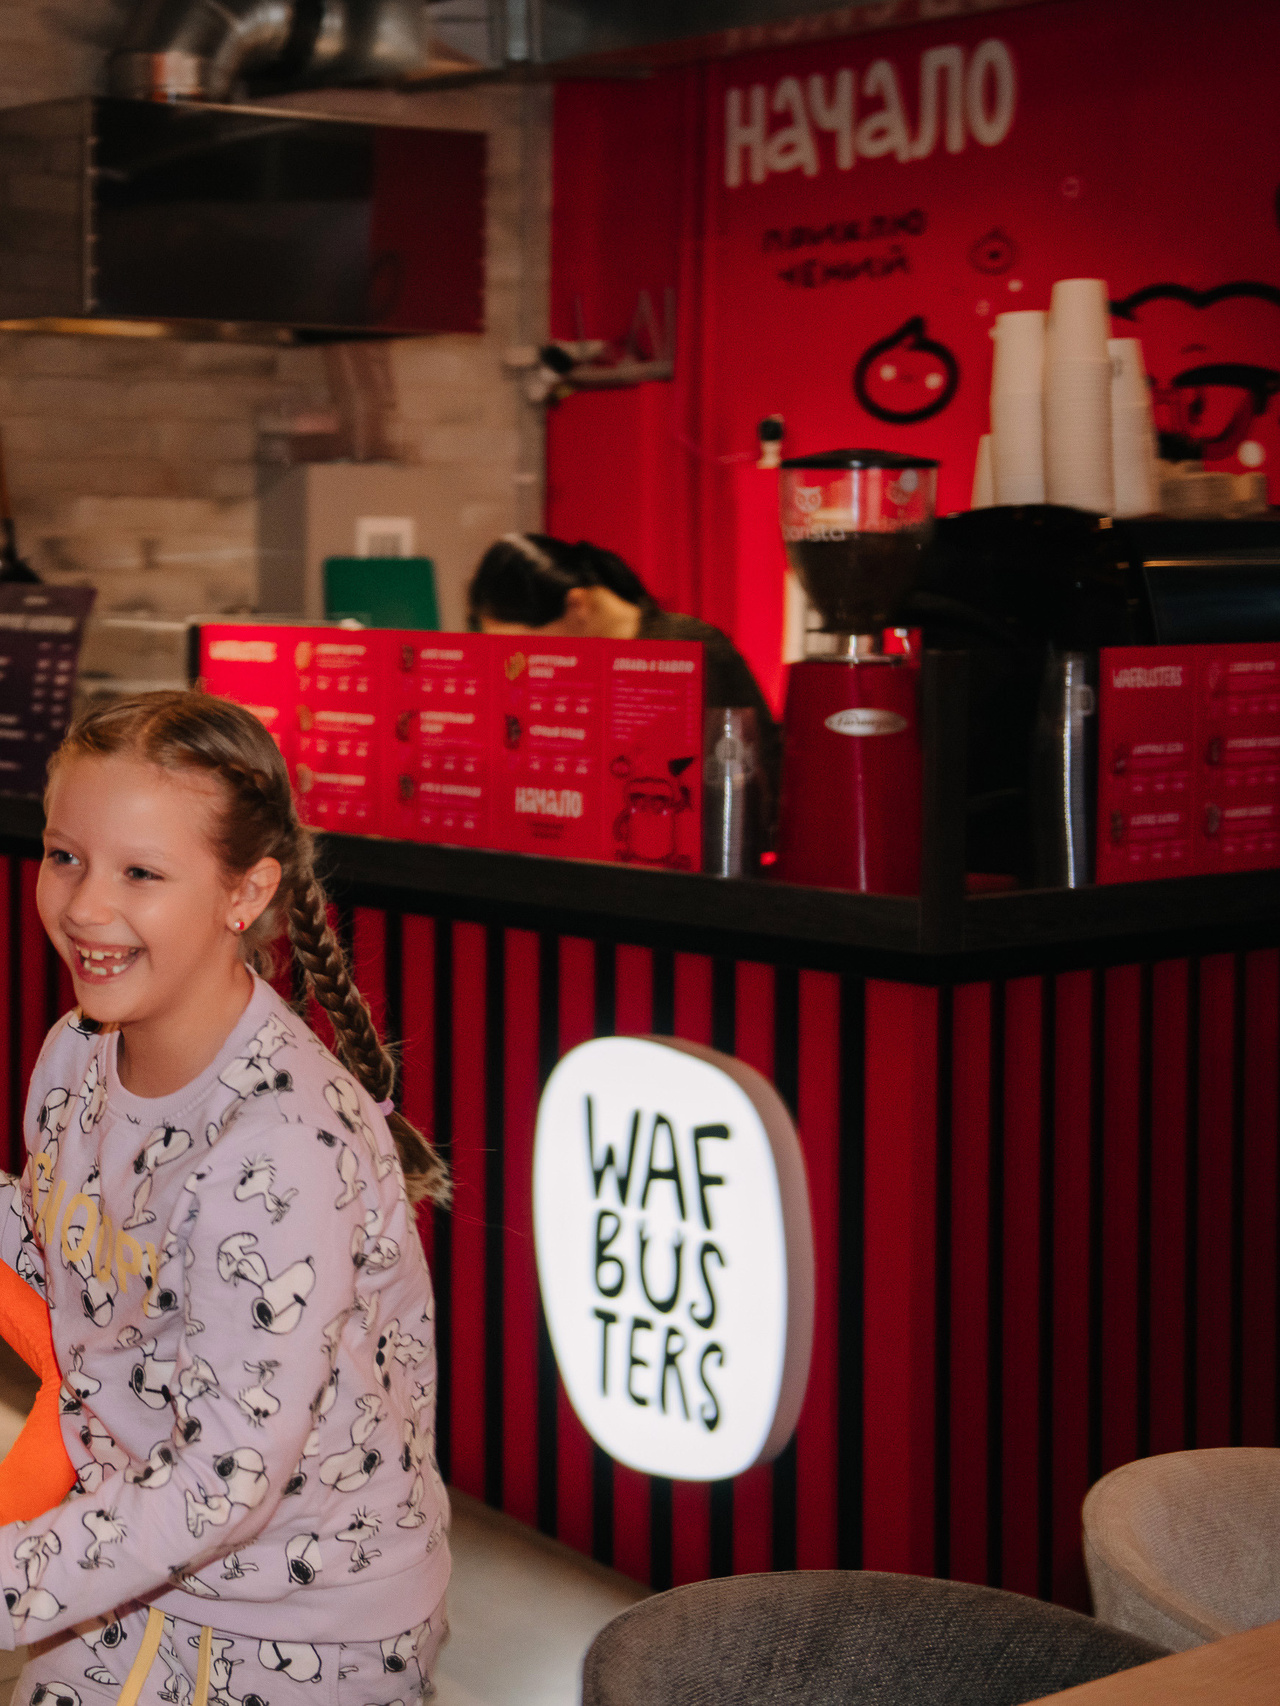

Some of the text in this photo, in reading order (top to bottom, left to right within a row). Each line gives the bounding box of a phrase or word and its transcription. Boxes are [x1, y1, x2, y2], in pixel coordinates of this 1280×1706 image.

[586, 1093, 730, 1230] WAF
[595, 1210, 726, 1329] BUS
[592, 1307, 726, 1432] TERS
